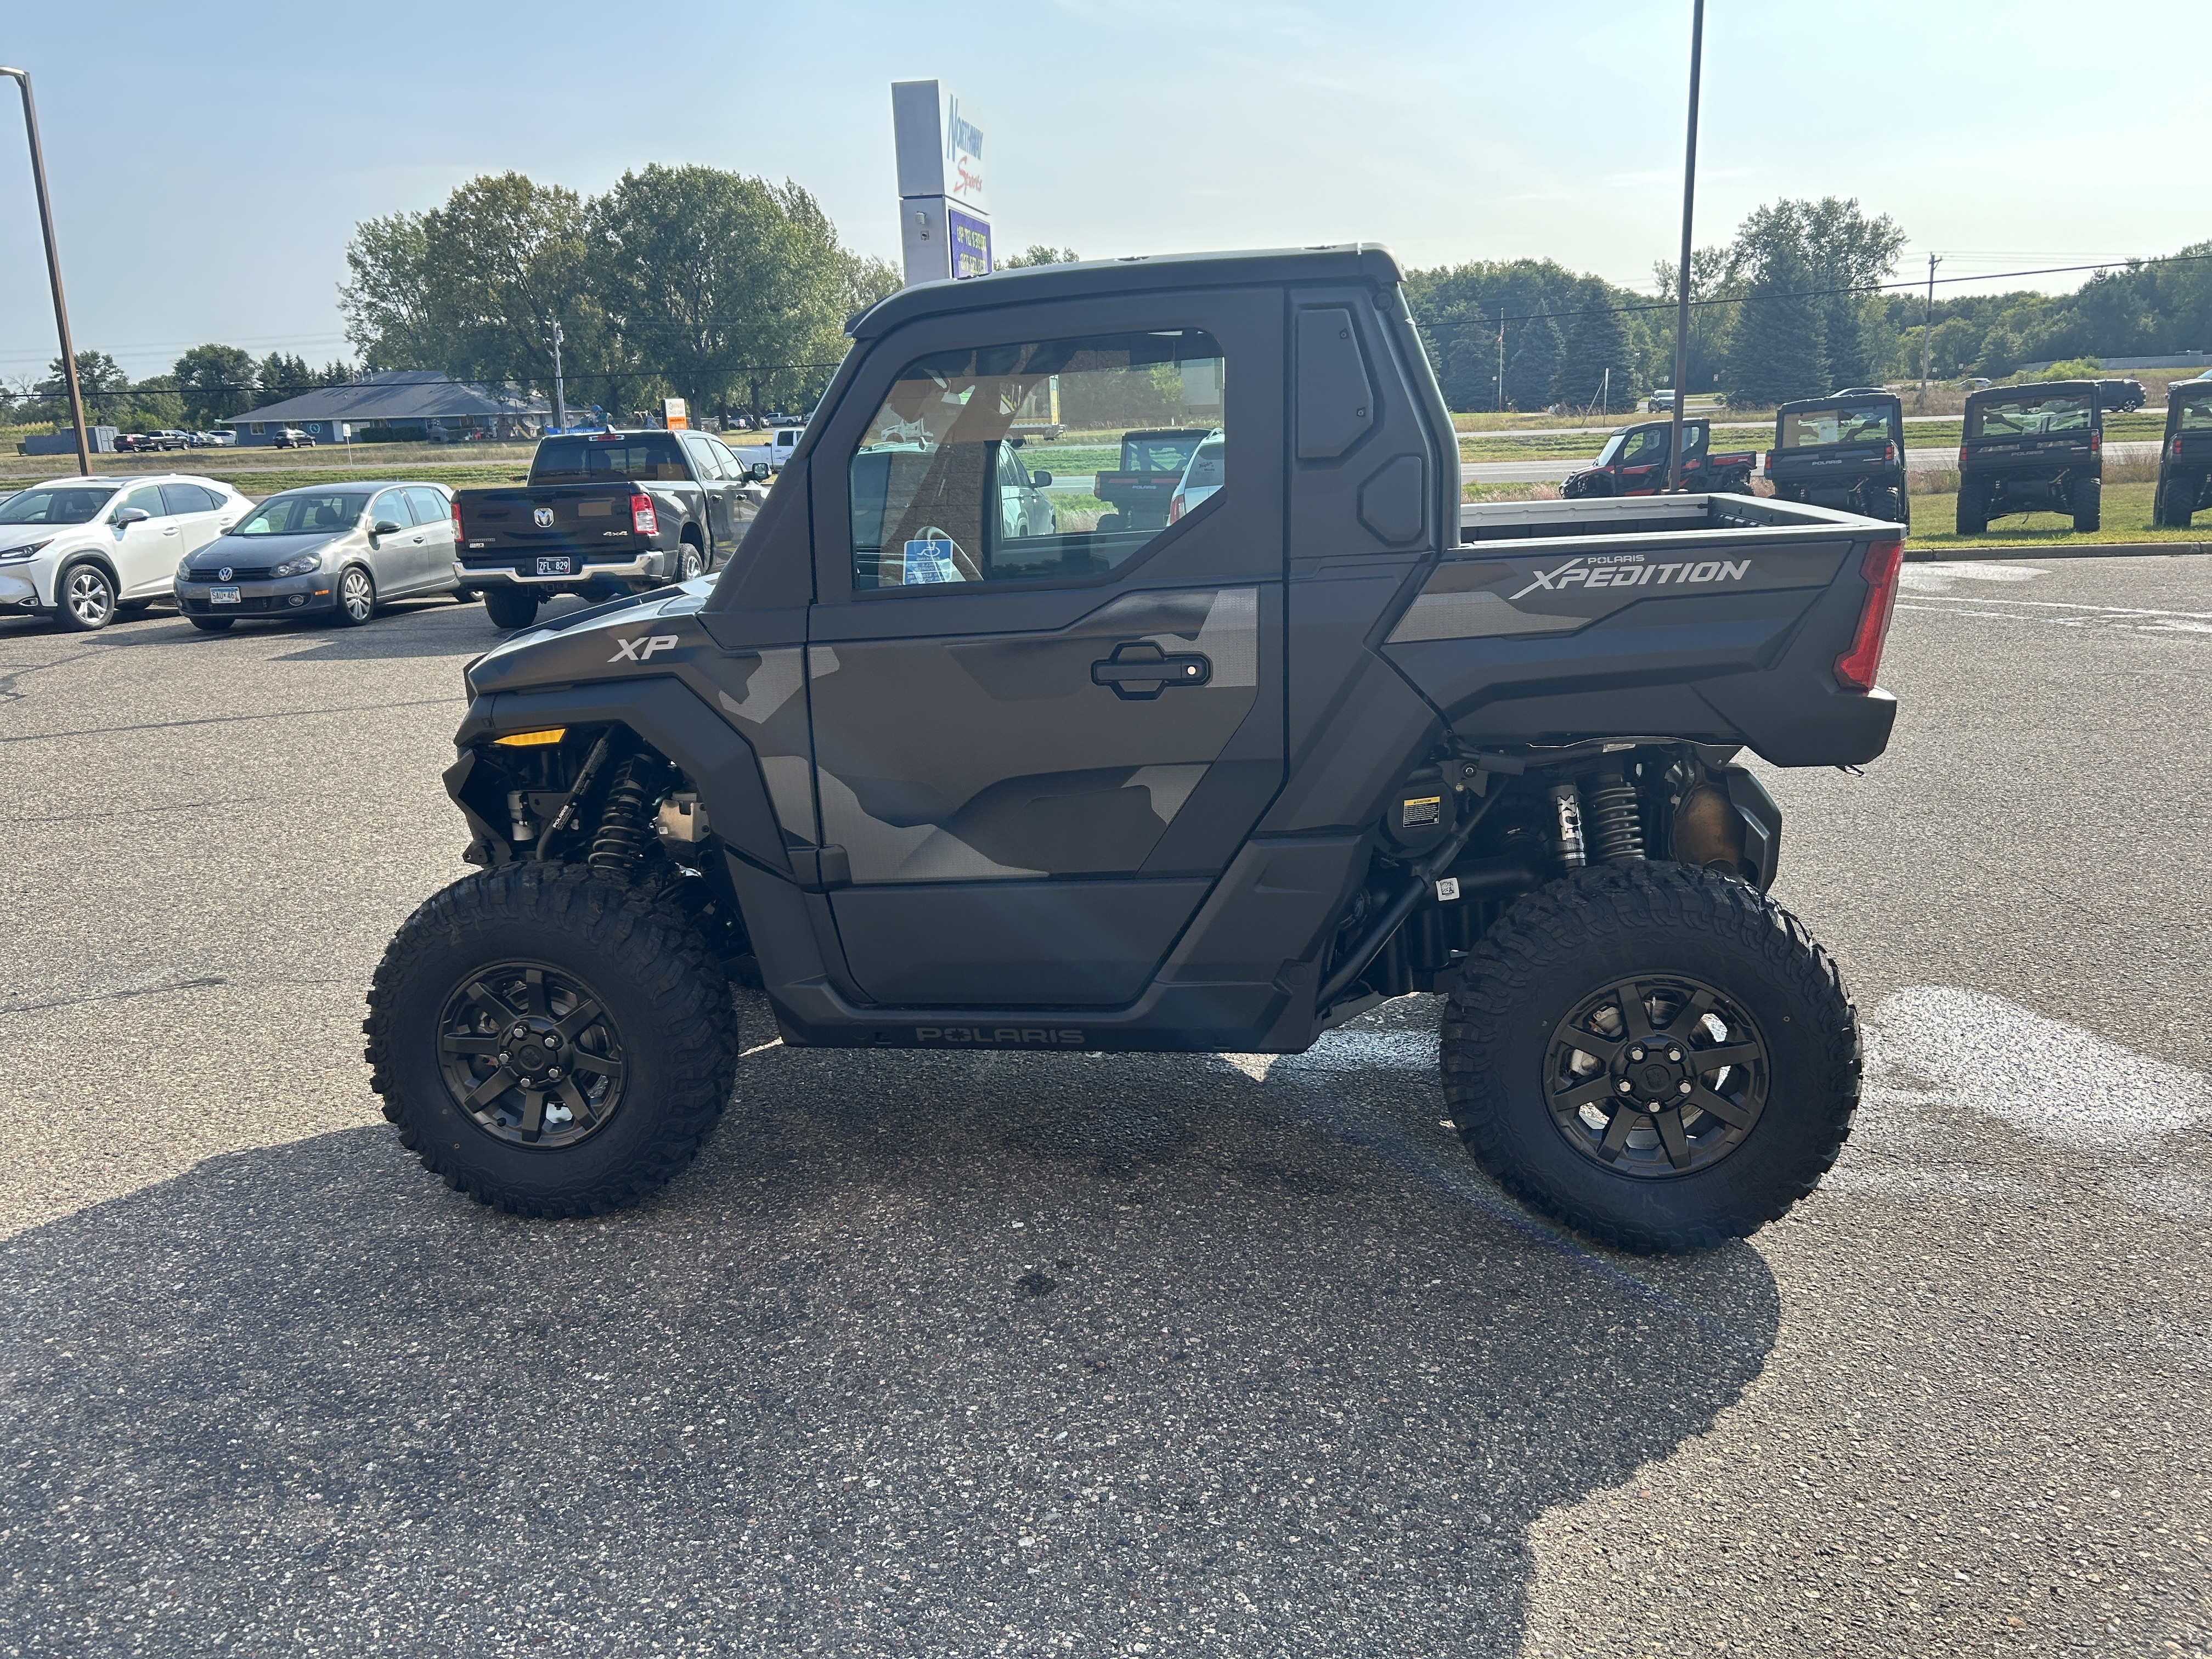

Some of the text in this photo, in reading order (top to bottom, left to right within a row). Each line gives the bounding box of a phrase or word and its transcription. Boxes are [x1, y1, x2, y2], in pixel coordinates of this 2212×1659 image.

[953, 155, 982, 196] Sports
[556, 561, 568, 570] 829
[1588, 554, 1645, 565] POLARIS
[1508, 558, 1751, 600] XPEDITION
[607, 635, 679, 663] XP
[552, 805, 568, 828] POLARIS
[1556, 794, 1581, 840] FOX
[916, 1027, 1085, 1043] POLARIS
